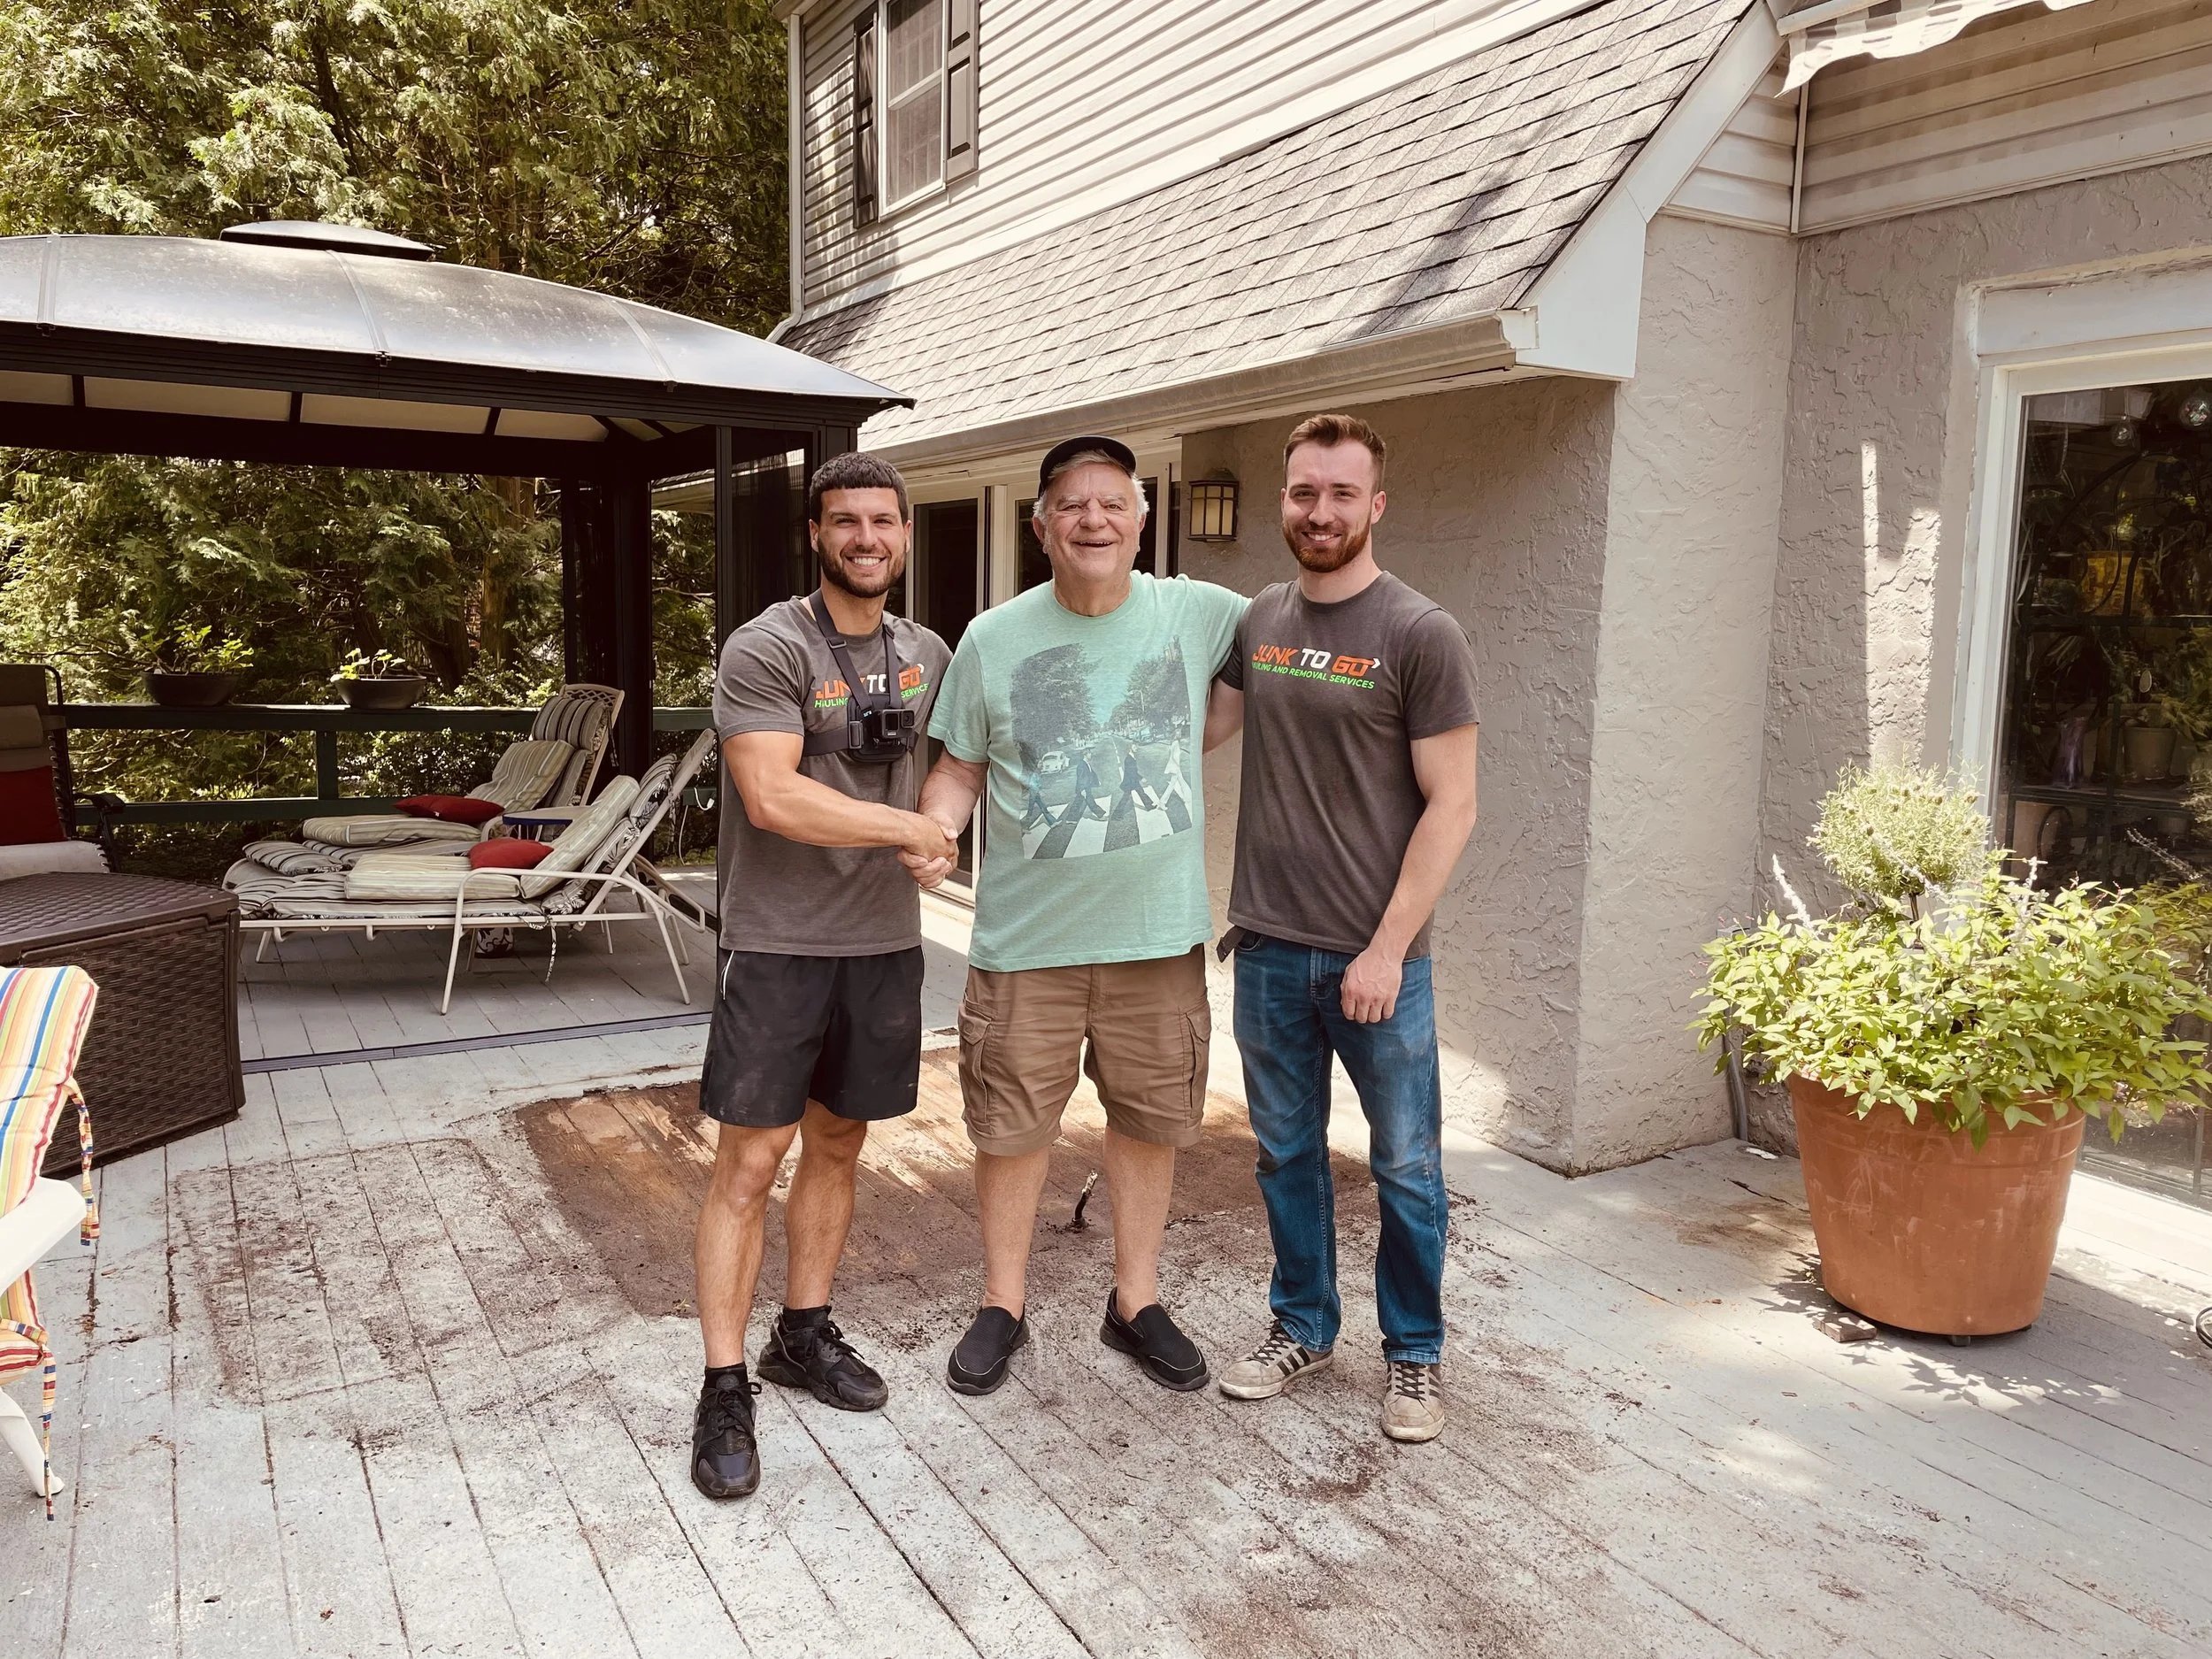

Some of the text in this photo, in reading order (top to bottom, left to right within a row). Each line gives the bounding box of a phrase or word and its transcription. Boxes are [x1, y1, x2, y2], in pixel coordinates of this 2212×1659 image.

[1252, 644, 1376, 678] JUNK TO GO
[1271, 665, 1289, 674] AND
[1288, 667, 1327, 681] REMOVAL
[1329, 674, 1375, 689] SERVICES
[900, 682, 930, 698] SERVICE
